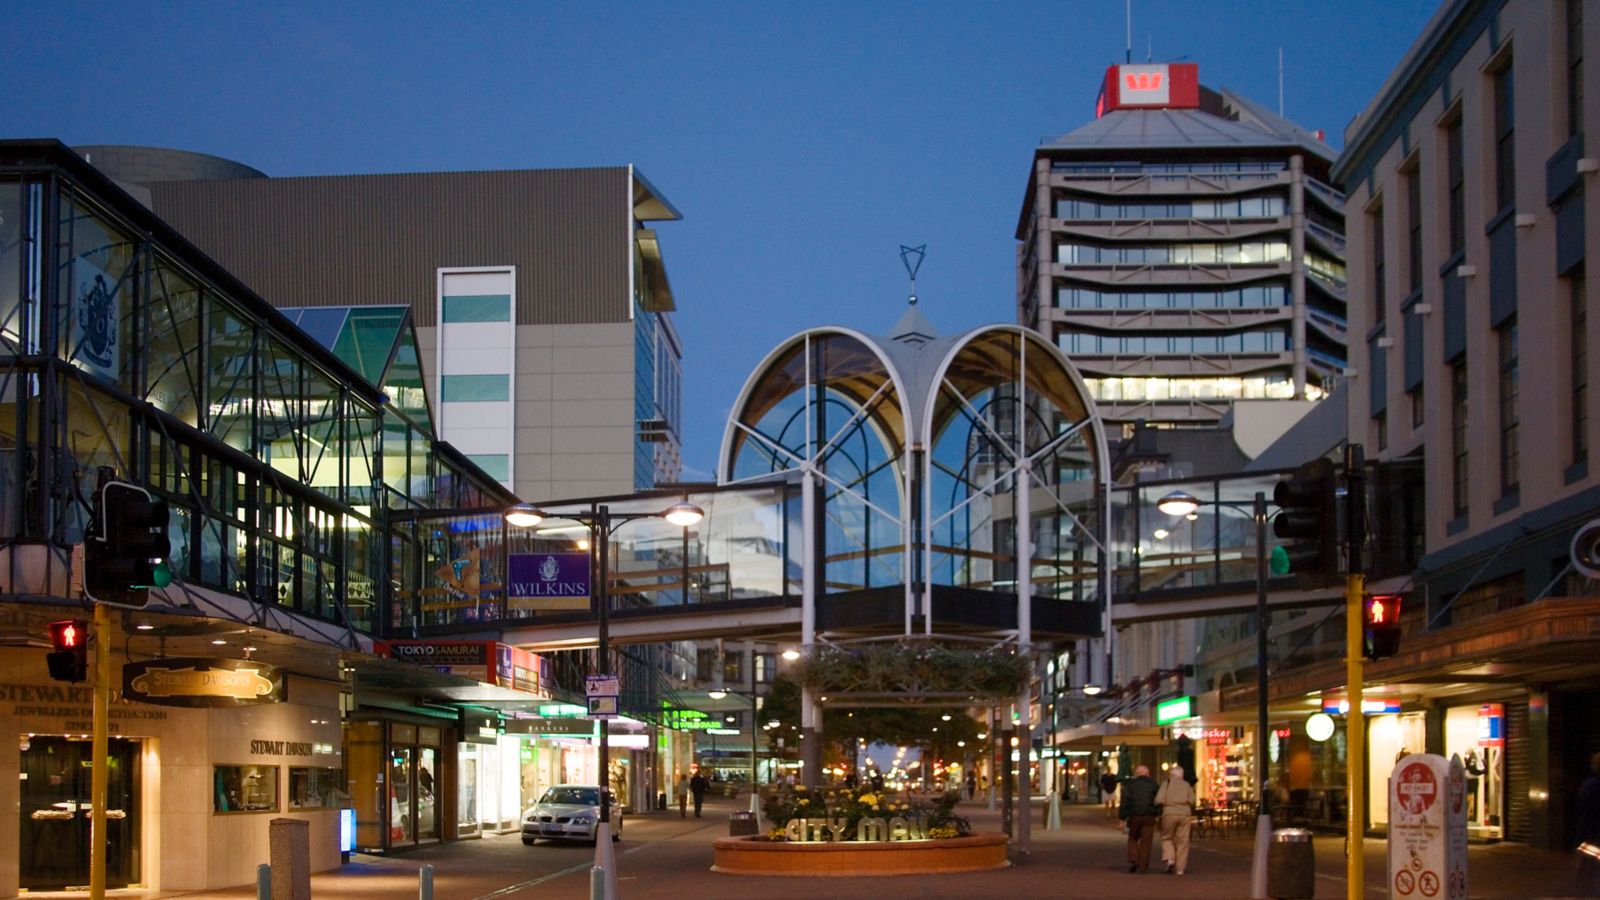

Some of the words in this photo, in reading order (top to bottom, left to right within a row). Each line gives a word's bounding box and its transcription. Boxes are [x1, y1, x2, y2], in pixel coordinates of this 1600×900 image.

[513, 582, 585, 596] WILKINS
[250, 740, 284, 756] STEWART
[285, 742, 313, 757] DAWSON
